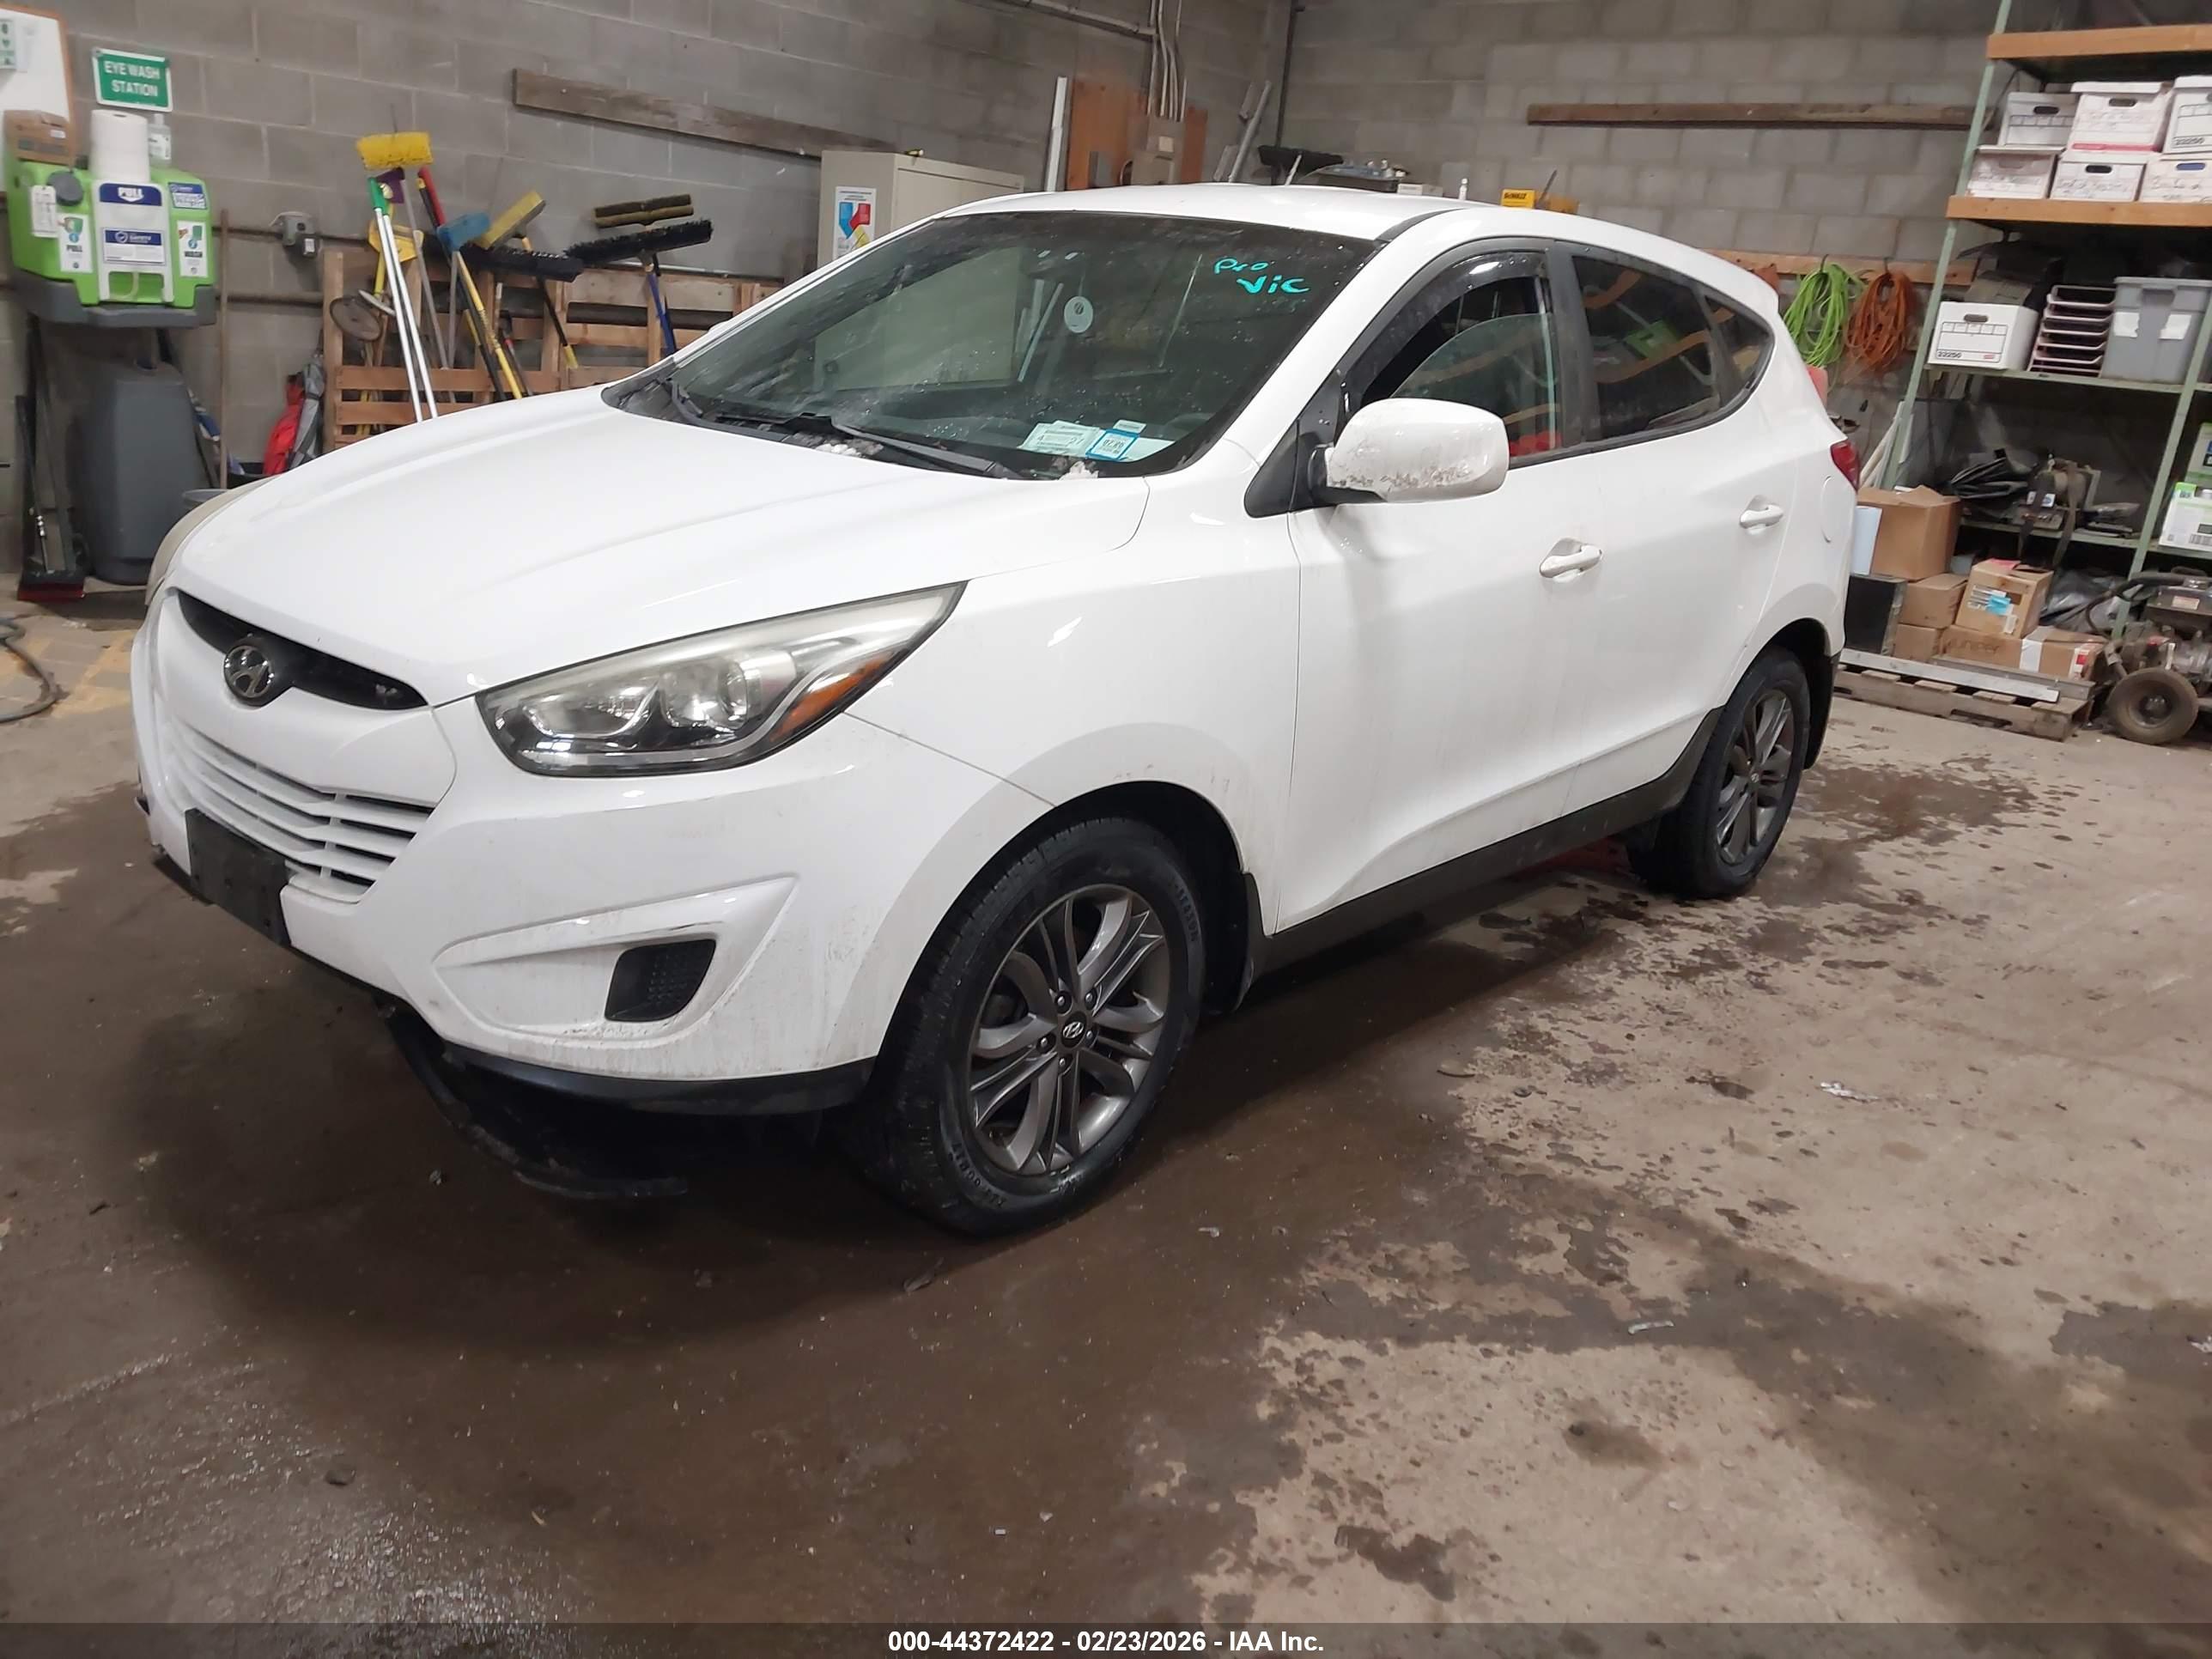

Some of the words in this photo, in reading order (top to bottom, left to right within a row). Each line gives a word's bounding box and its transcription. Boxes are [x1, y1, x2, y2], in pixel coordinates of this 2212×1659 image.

[104, 61, 127, 75] EYE
[128, 64, 161, 79] WASH
[112, 79, 158, 96] STATION
[118, 186, 143, 198] PULL
[1214, 258, 1269, 274] Pro
